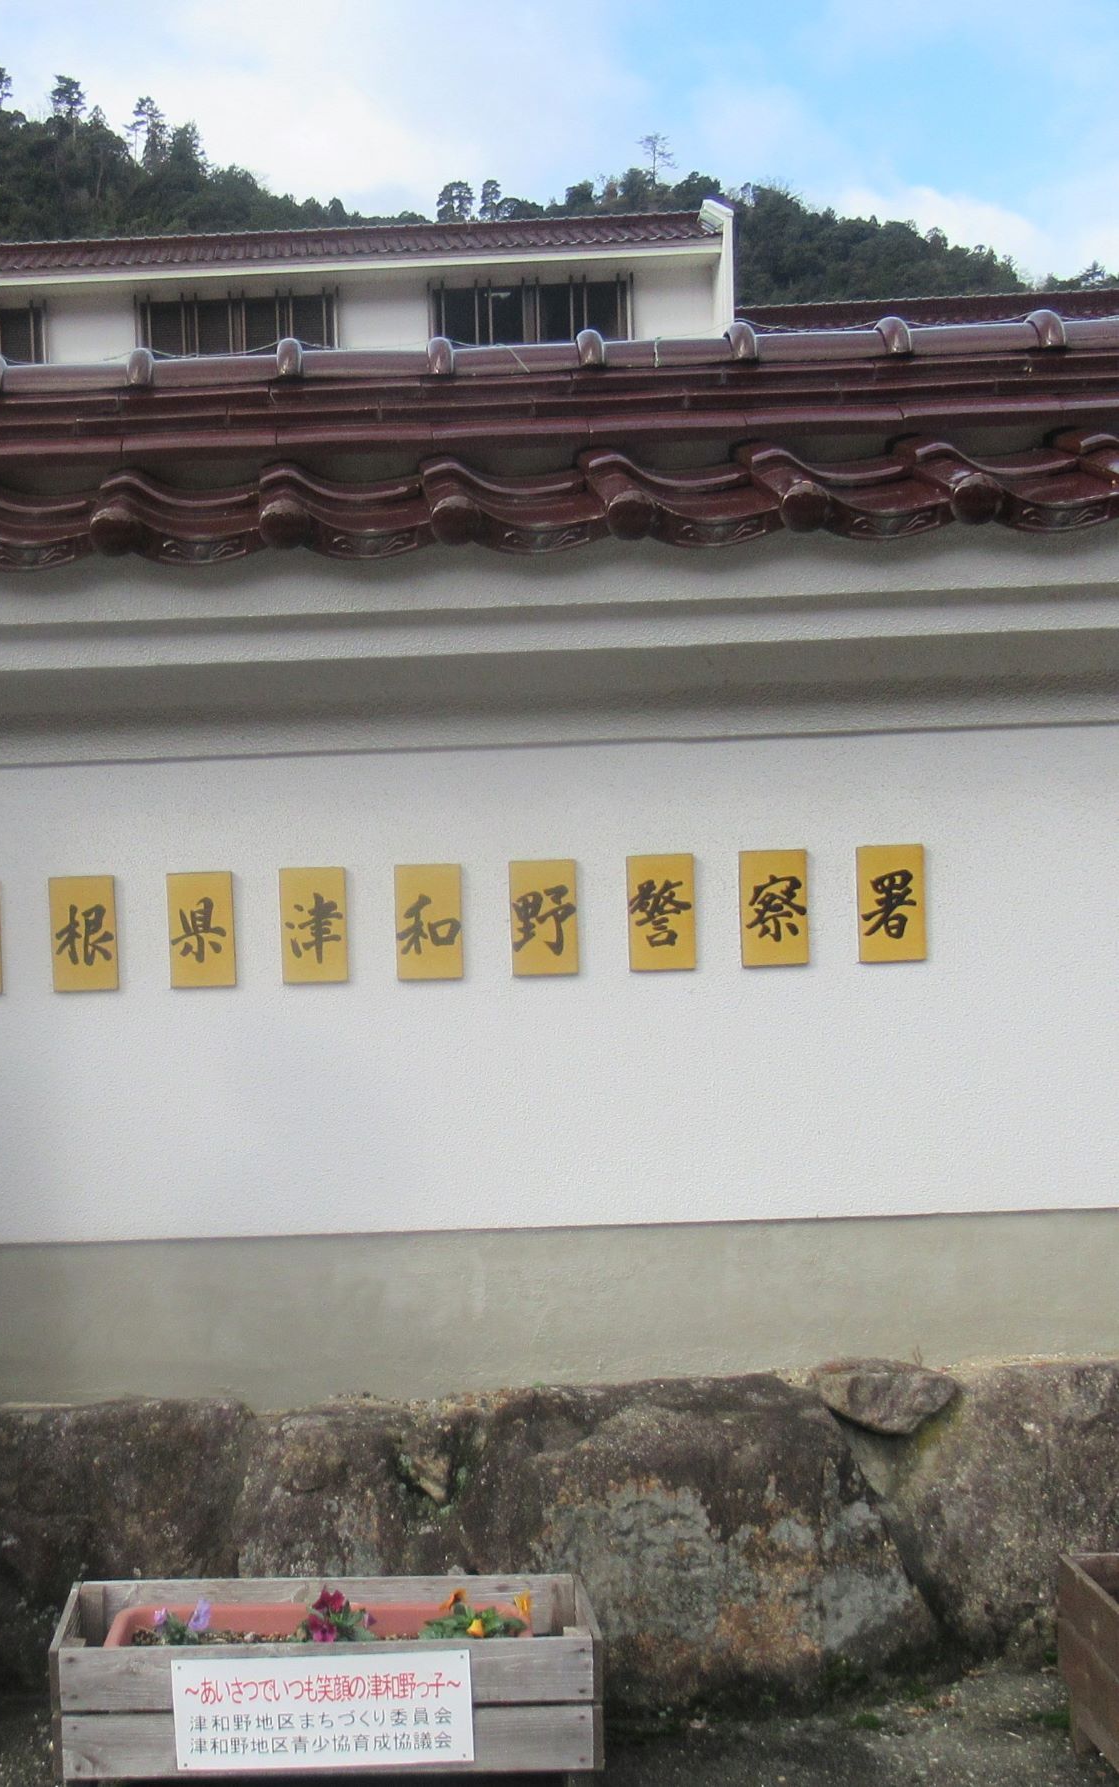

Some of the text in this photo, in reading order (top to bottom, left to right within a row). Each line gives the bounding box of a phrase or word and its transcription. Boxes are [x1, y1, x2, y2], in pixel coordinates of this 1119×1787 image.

[189, 1706, 452, 1733] 津和野地区まちづくり委員会
